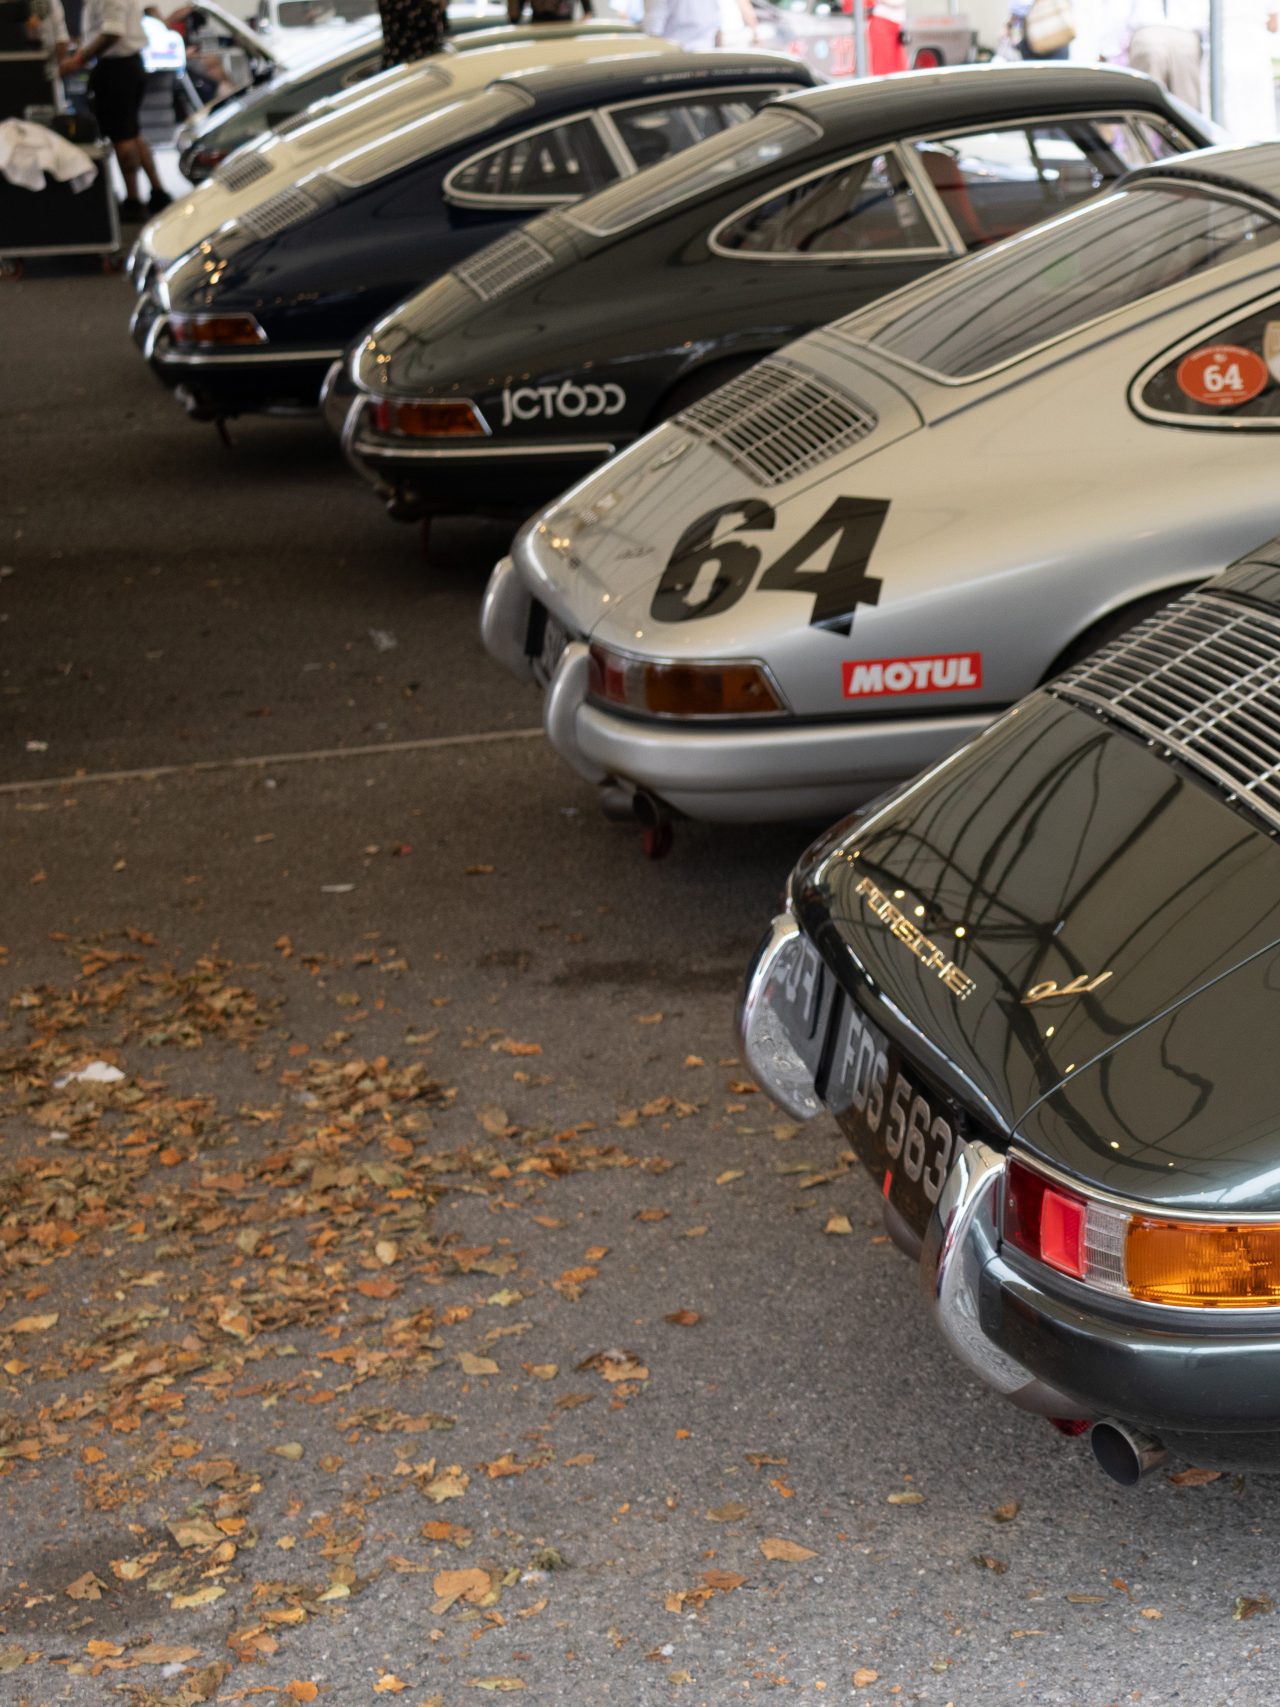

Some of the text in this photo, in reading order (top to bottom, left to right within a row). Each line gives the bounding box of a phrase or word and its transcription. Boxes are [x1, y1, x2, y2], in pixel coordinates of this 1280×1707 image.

[1203, 363, 1244, 392] 64
[650, 496, 892, 638] 64
[848, 658, 977, 695] MOTUL
[855, 877, 977, 1000] PORSCHE
[885, 1072, 953, 1205] 563
